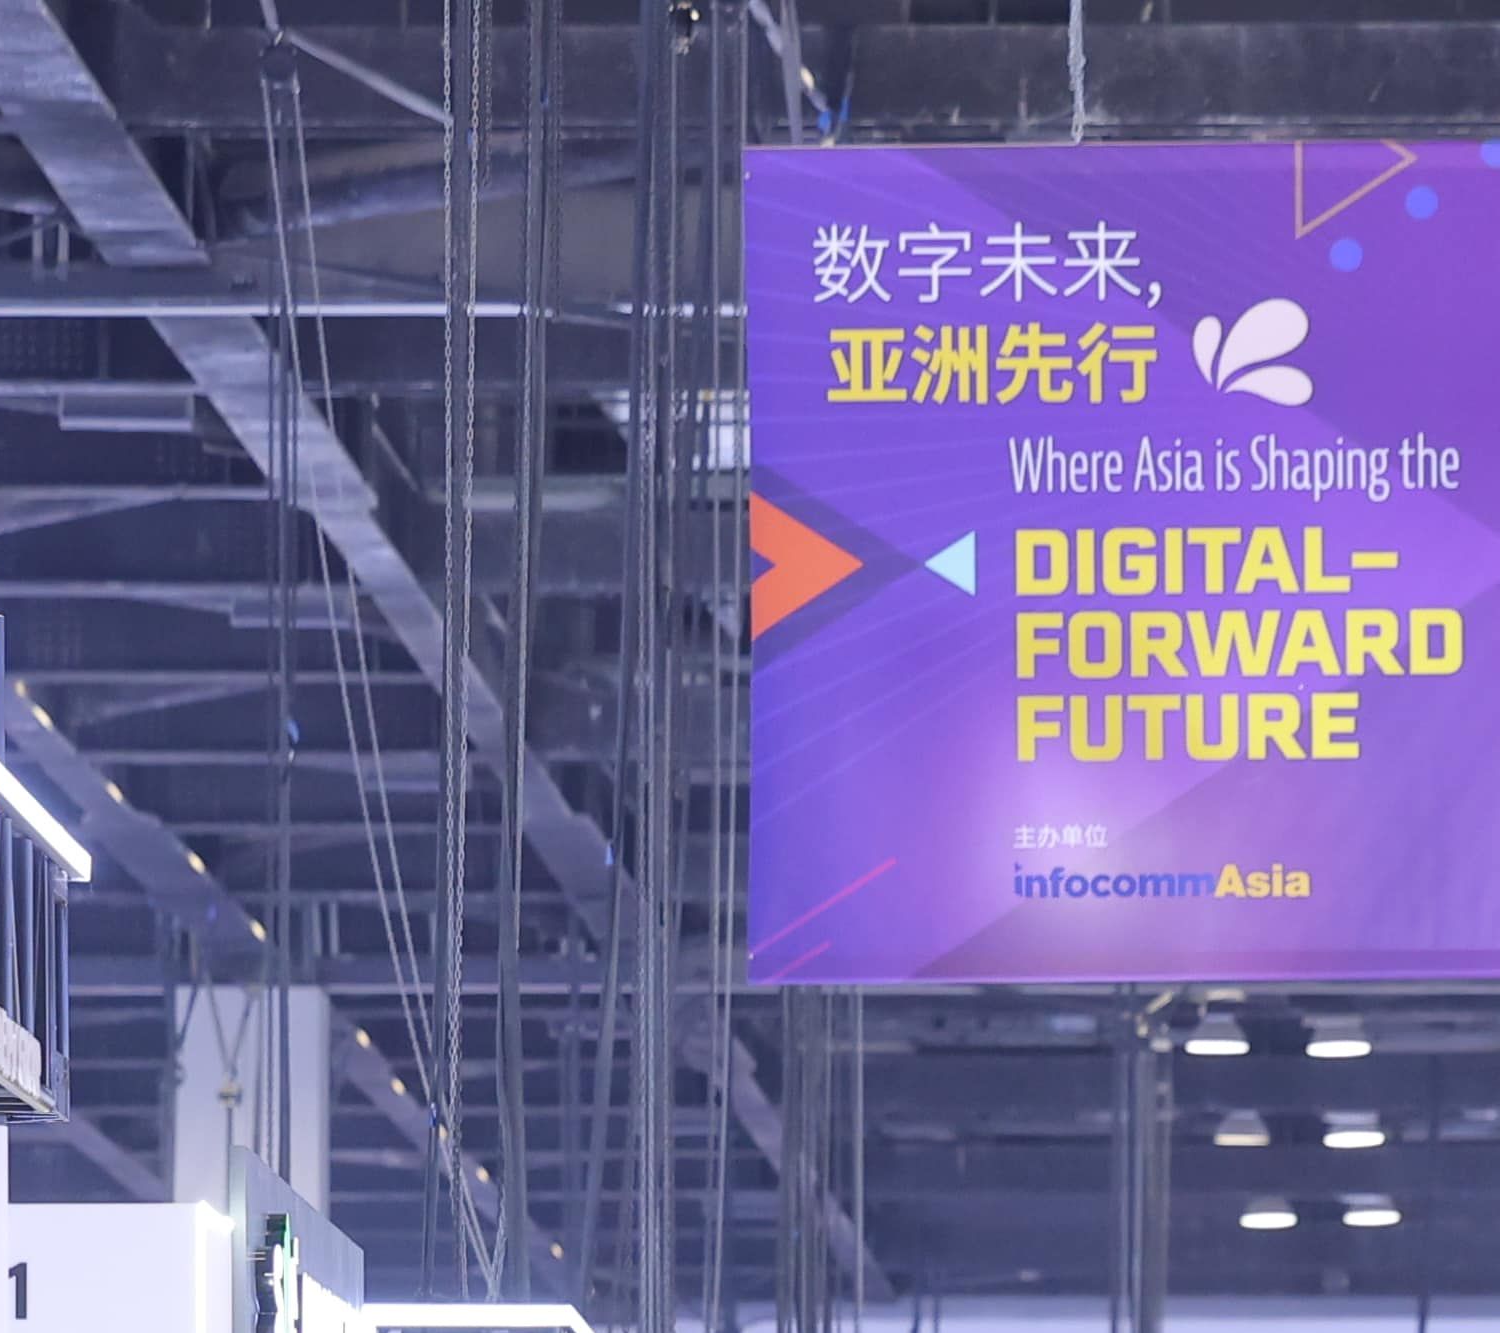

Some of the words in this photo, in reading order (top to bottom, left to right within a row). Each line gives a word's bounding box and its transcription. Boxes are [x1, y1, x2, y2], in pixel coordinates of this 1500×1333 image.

[812, 221, 1162, 308] 数字未来,
[827, 321, 1158, 405] 亚洲先行
[1008, 437, 1123, 494] Where
[1134, 437, 1205, 493] Asia
[1215, 438, 1241, 491] is
[1249, 435, 1390, 502] Shaping
[1399, 433, 1460, 490] the
[1015, 608, 1465, 680] FORWARD
[1015, 692, 1361, 762] FUTURE
[1013, 824, 1108, 849] 主办单位
[1013, 863, 1311, 899] infocommAsia
